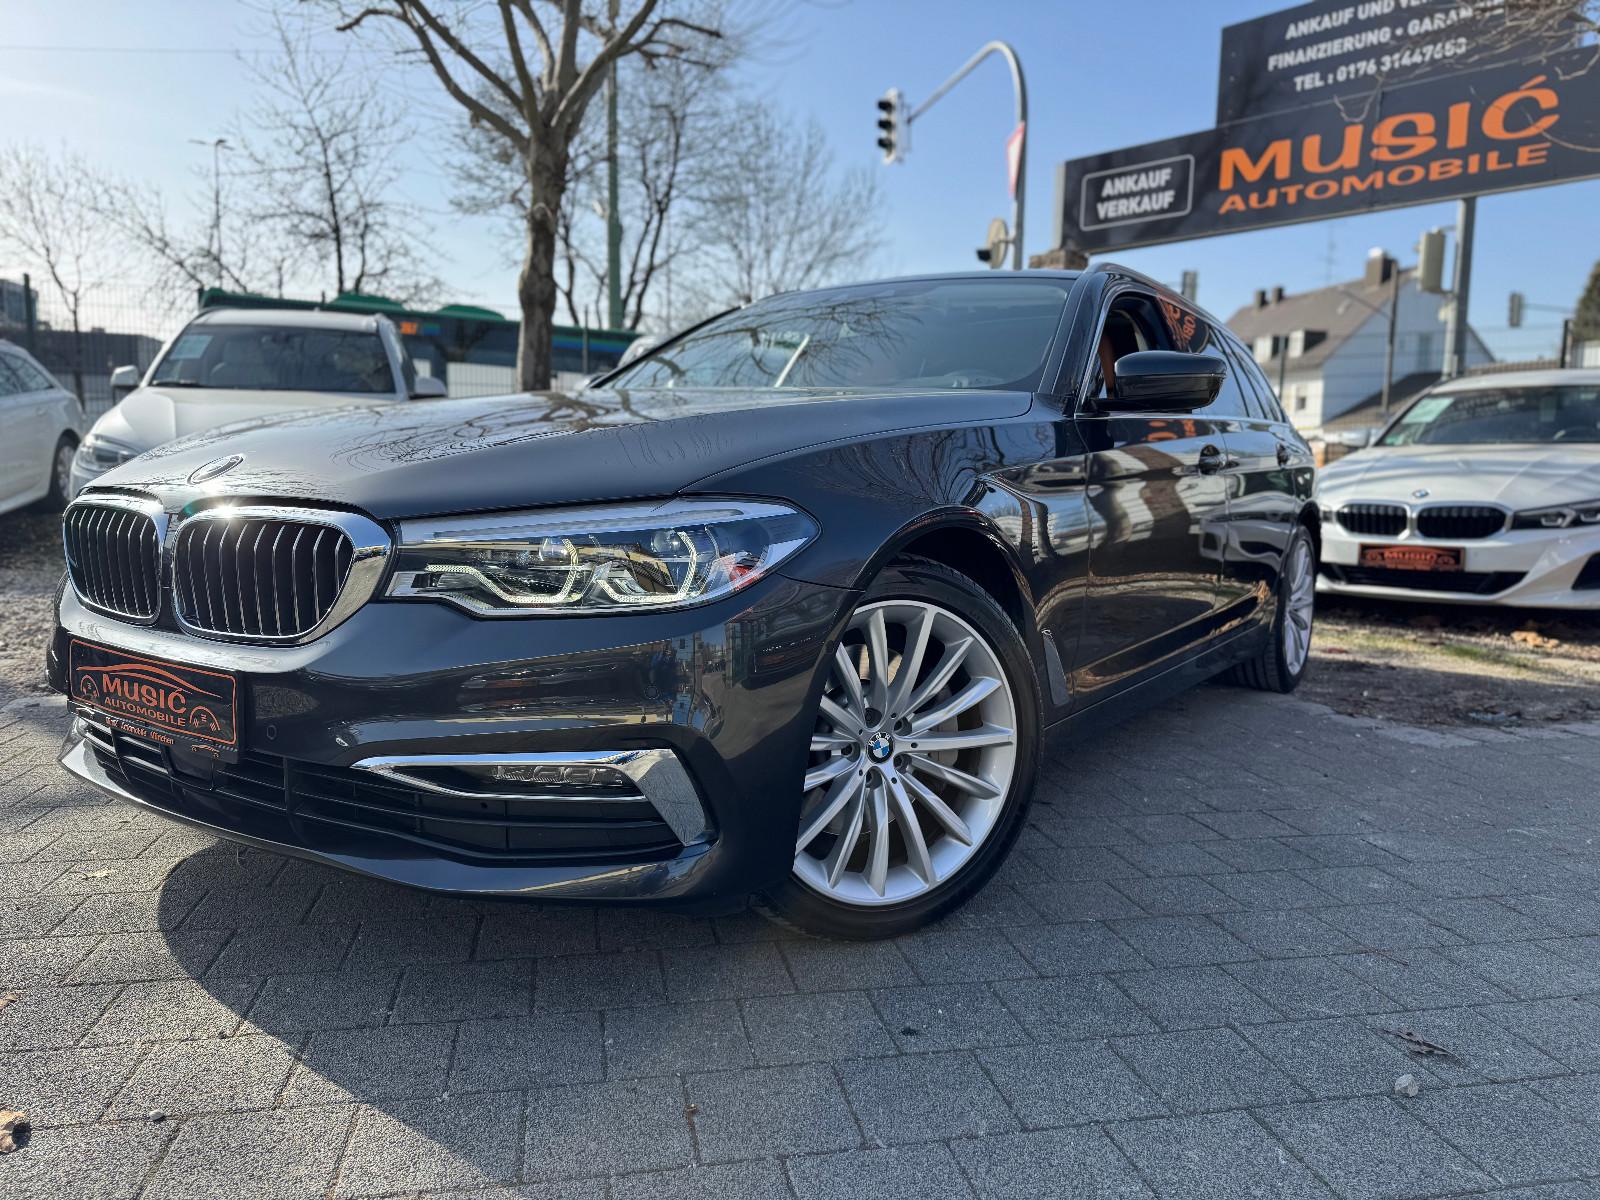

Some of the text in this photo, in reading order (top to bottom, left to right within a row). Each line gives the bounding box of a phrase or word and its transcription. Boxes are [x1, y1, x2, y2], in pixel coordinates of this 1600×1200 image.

[1285, 0, 1395, 40] ANKAUF UND
[1267, 26, 1391, 72] FINANZIERUNG
[1336, 58, 1377, 82] 0176
[1218, 75, 1560, 191] MUSIĆ
[1101, 168, 1172, 198] ANKAUF
[1218, 142, 1552, 215] AUTOMOBILE
[1096, 190, 1175, 220] VERKAUF
[102, 673, 187, 714] MUSIĆ
[104, 696, 187, 727] AUTOMOBILE
